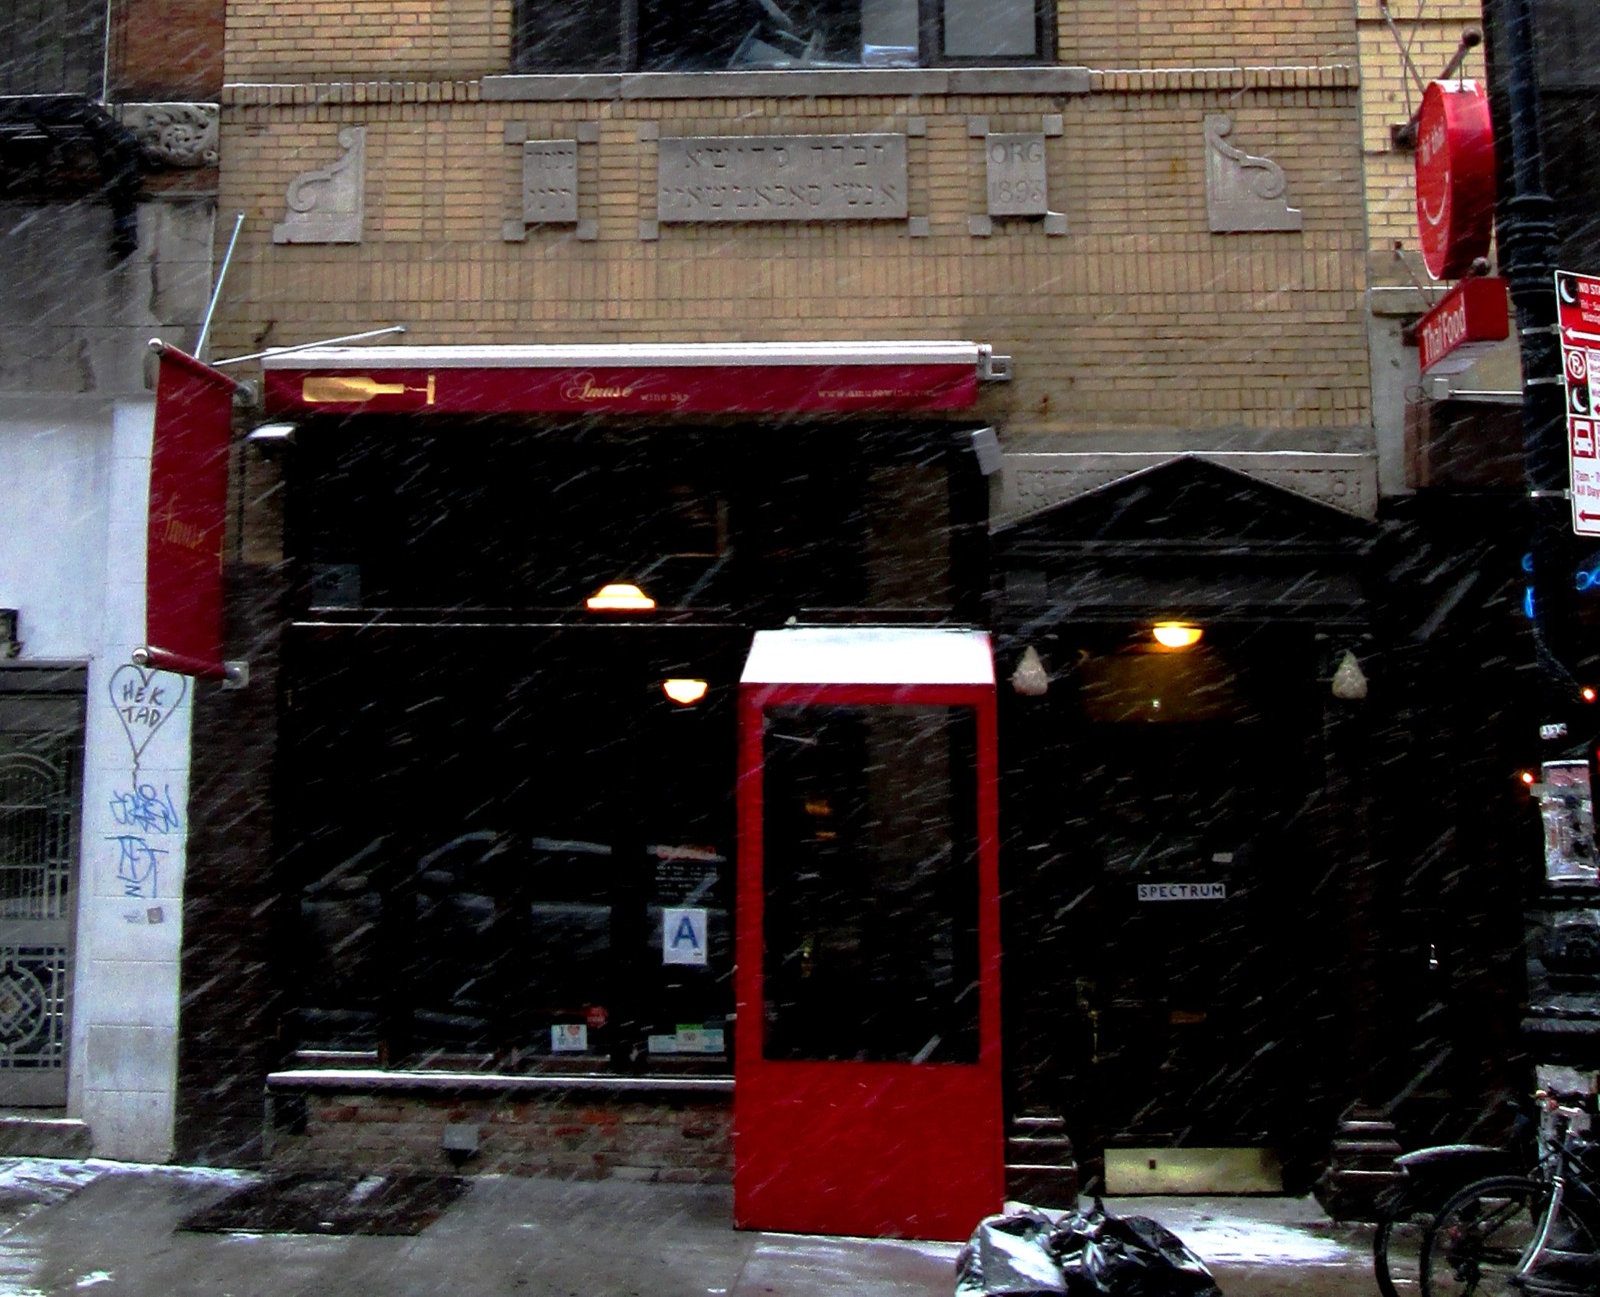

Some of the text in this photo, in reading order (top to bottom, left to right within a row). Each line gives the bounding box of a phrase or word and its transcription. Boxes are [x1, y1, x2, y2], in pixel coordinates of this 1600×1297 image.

[990, 141, 1043, 164] ORG
[1422, 305, 1465, 363] Thai Food
[560, 372, 635, 403] Amuse
[640, 393, 667, 402] wine
[670, 392, 689, 402] bar
[121, 706, 161, 728] TAD
[1140, 885, 1223, 898] SPECTRUM
[671, 916, 699, 949] A
